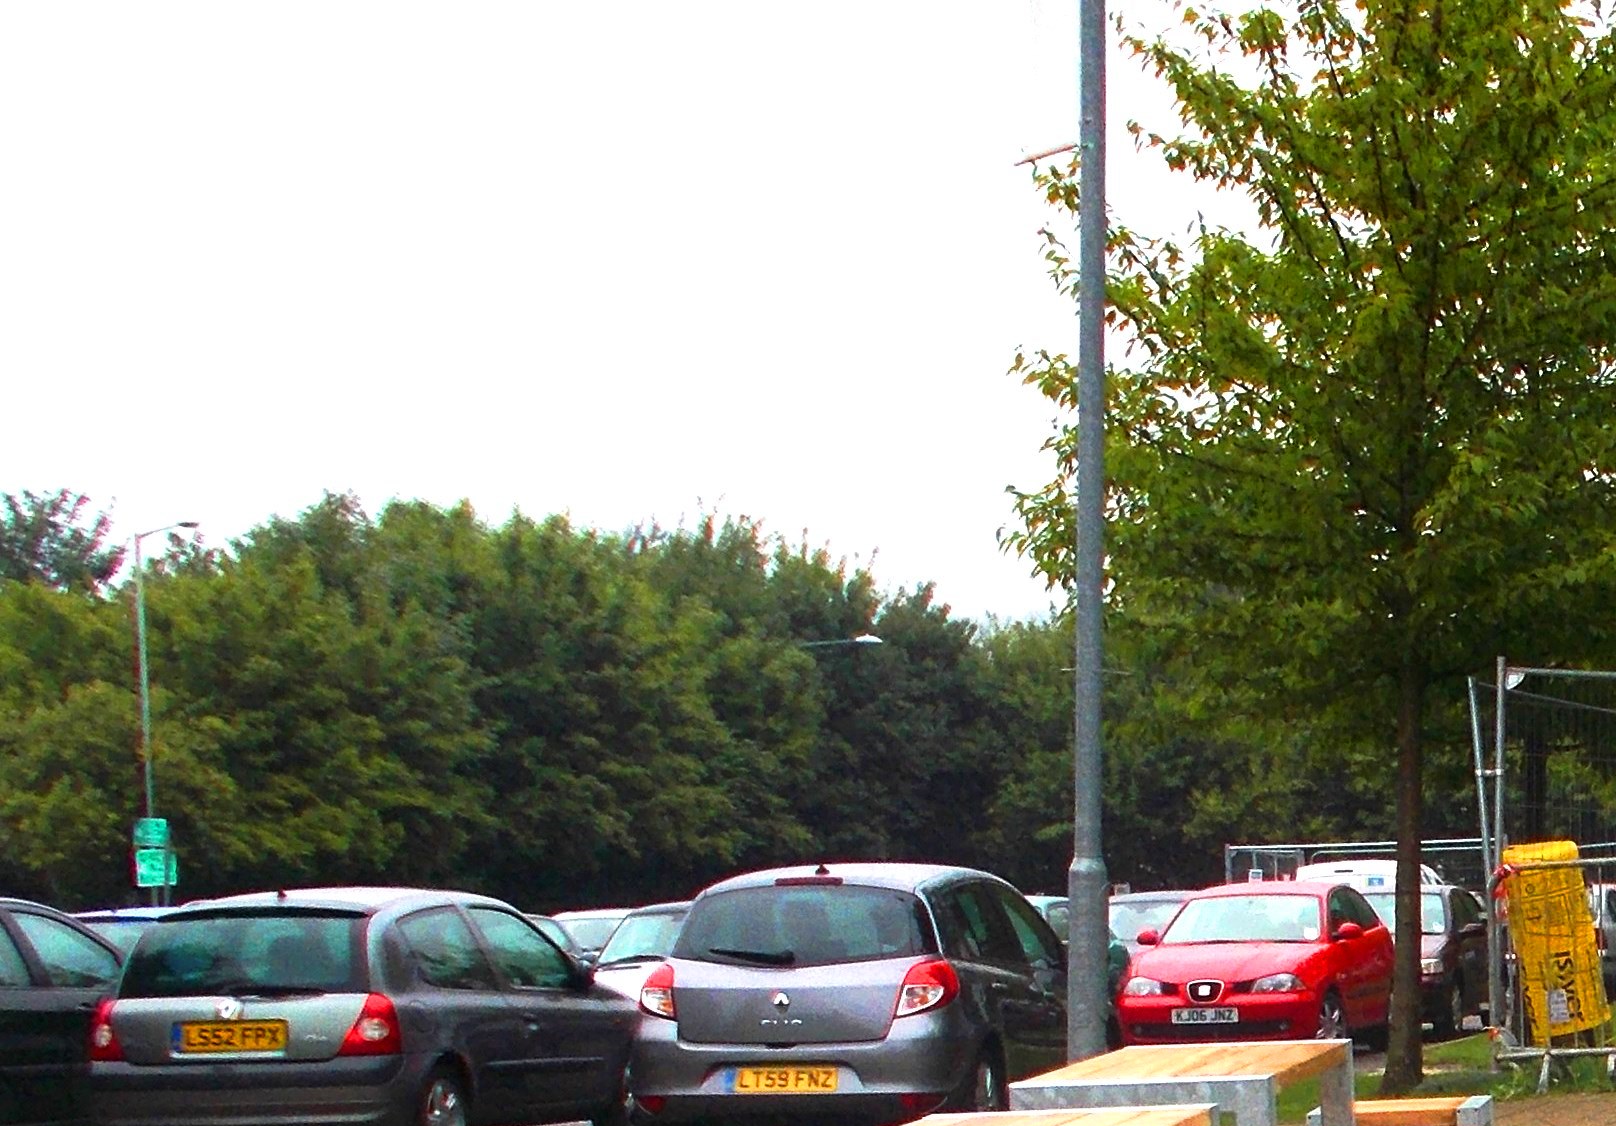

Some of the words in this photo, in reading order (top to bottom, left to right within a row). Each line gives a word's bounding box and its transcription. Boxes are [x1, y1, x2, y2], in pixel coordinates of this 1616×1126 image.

[186, 1028, 236, 1048] LS52
[241, 1026, 280, 1046] FPX
[739, 1071, 789, 1089] LT59
[794, 1070, 834, 1089] FNZ
